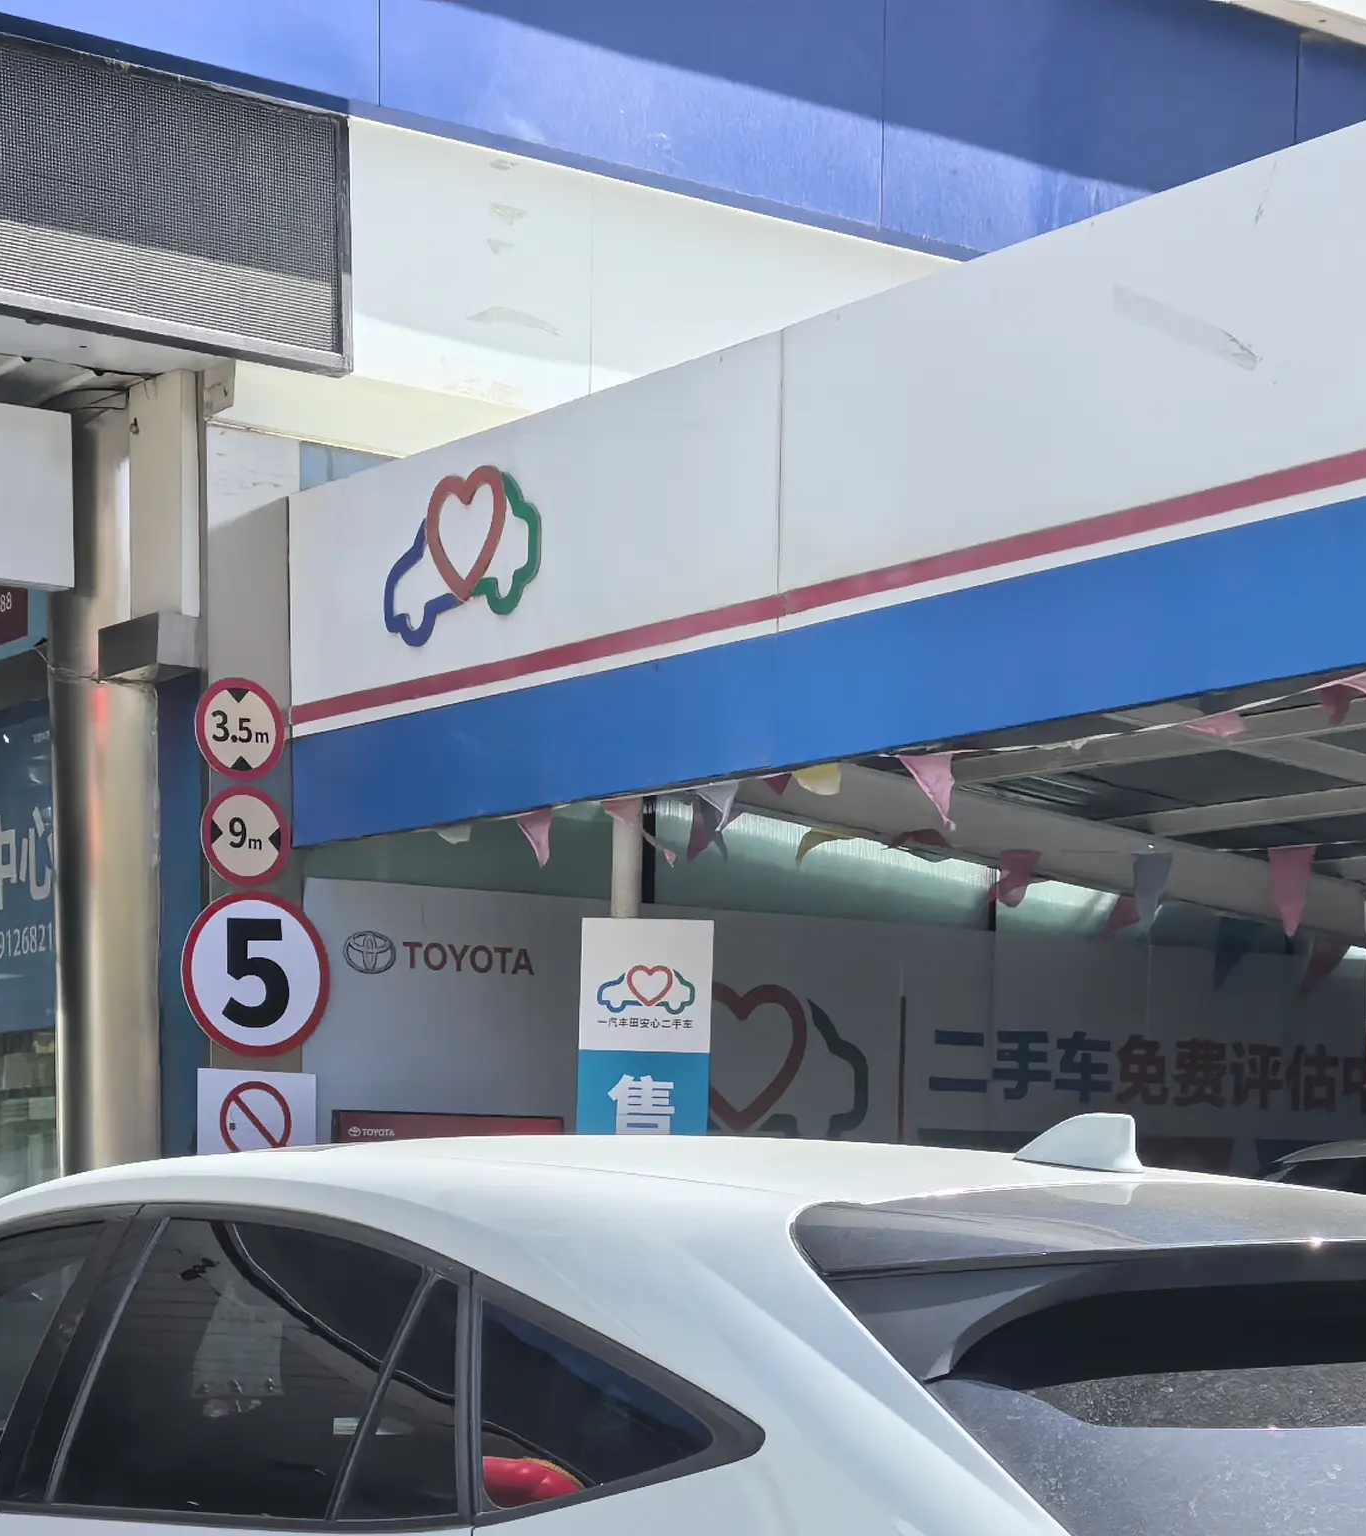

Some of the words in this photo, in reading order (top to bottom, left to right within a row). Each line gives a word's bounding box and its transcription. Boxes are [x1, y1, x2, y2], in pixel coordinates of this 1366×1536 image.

[211, 709, 269, 744] 3.5m
[228, 817, 263, 850] 9m
[222, 917, 290, 1028] 5
[402, 940, 534, 976] TOYOTA
[597, 1017, 694, 1030] 一汽丰田安心二手车
[607, 1074, 675, 1134] 售
[361, 1128, 395, 1137] TOYOTA
